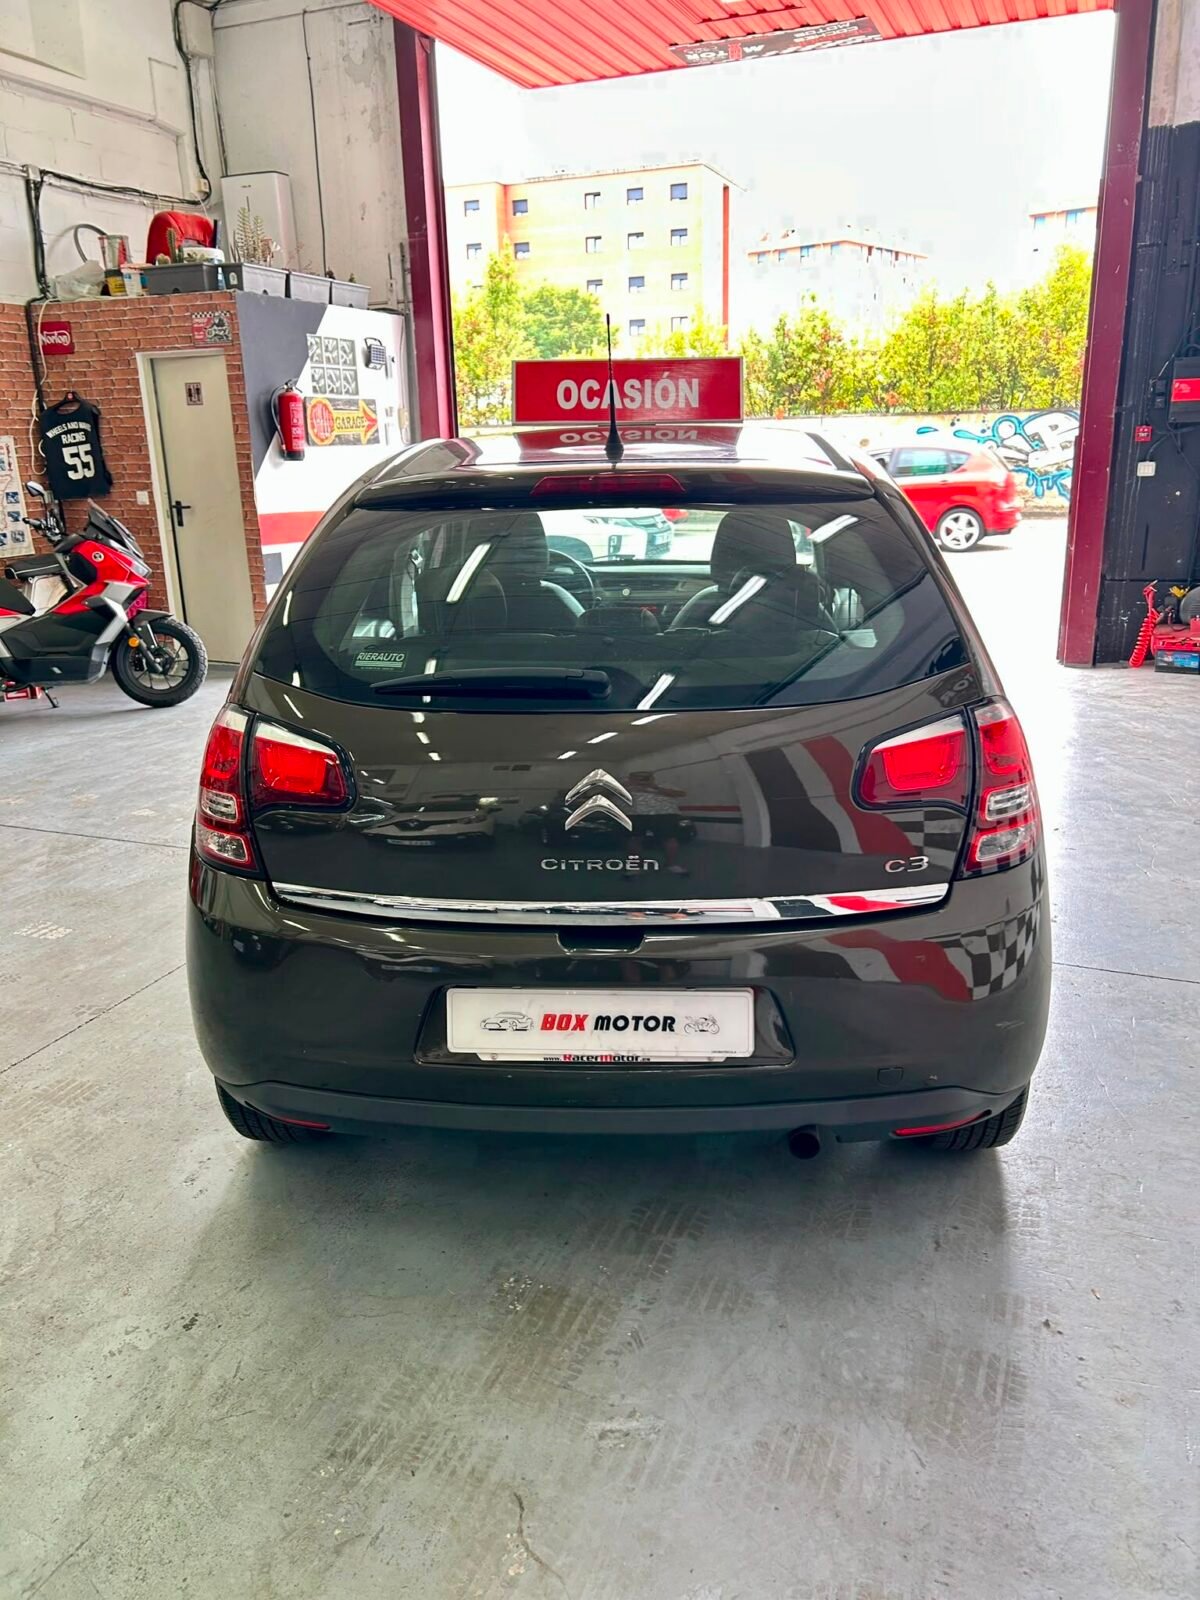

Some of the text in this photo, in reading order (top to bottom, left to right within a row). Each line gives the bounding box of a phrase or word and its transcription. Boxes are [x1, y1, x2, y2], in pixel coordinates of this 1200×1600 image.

[40, 330, 70, 346] Norton
[556, 371, 699, 410] OCASIÓN
[46, 423, 68, 439] WHEELS
[67, 421, 79, 430] AND
[335, 416, 365, 430] GARAGE
[61, 432, 86, 444] RACING
[62, 443, 95, 480] 55
[356, 652, 405, 662] RIERAUTO
[883, 855, 930, 874] C3
[540, 1013, 676, 1032] BOX MOTOR
